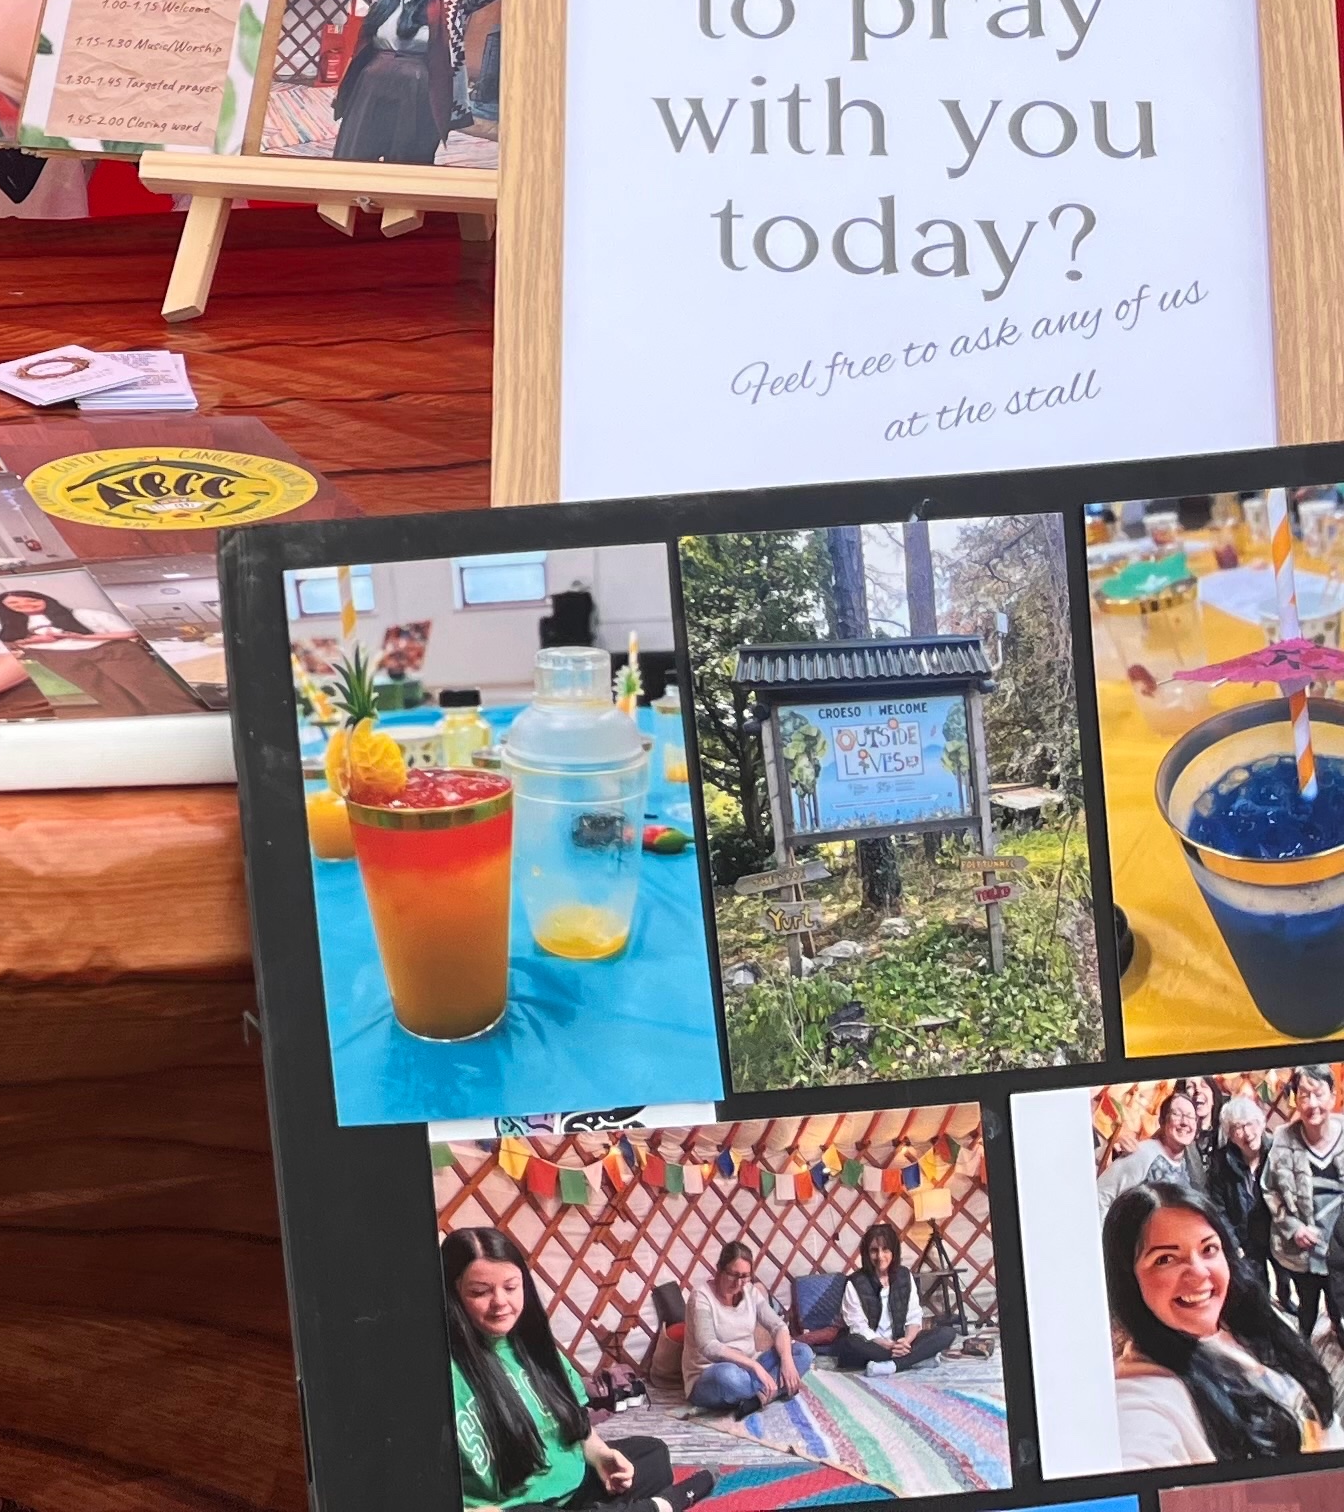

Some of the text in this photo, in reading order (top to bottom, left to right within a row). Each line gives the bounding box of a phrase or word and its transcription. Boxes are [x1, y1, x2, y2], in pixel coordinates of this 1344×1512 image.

[162, 1, 211, 14] Welcome
[75, 36, 223, 57] 1.15-1.30 Music/Worship
[65, 74, 218, 94] 1.30-1.45 Targeted prayer
[127, 117, 167, 133] Closing
[171, 120, 201, 133] word
[651, 75, 1158, 180] with you
[710, 194, 1098, 303] today?
[731, 280, 1208, 405] Feel free to ask any of us
[884, 368, 1102, 442] at the stall
[818, 702, 928, 720] CROESO WELCOME
[835, 718, 918, 752] OUTSIDE
[844, 748, 905, 776] LIVES
[767, 904, 814, 931] Yurt
